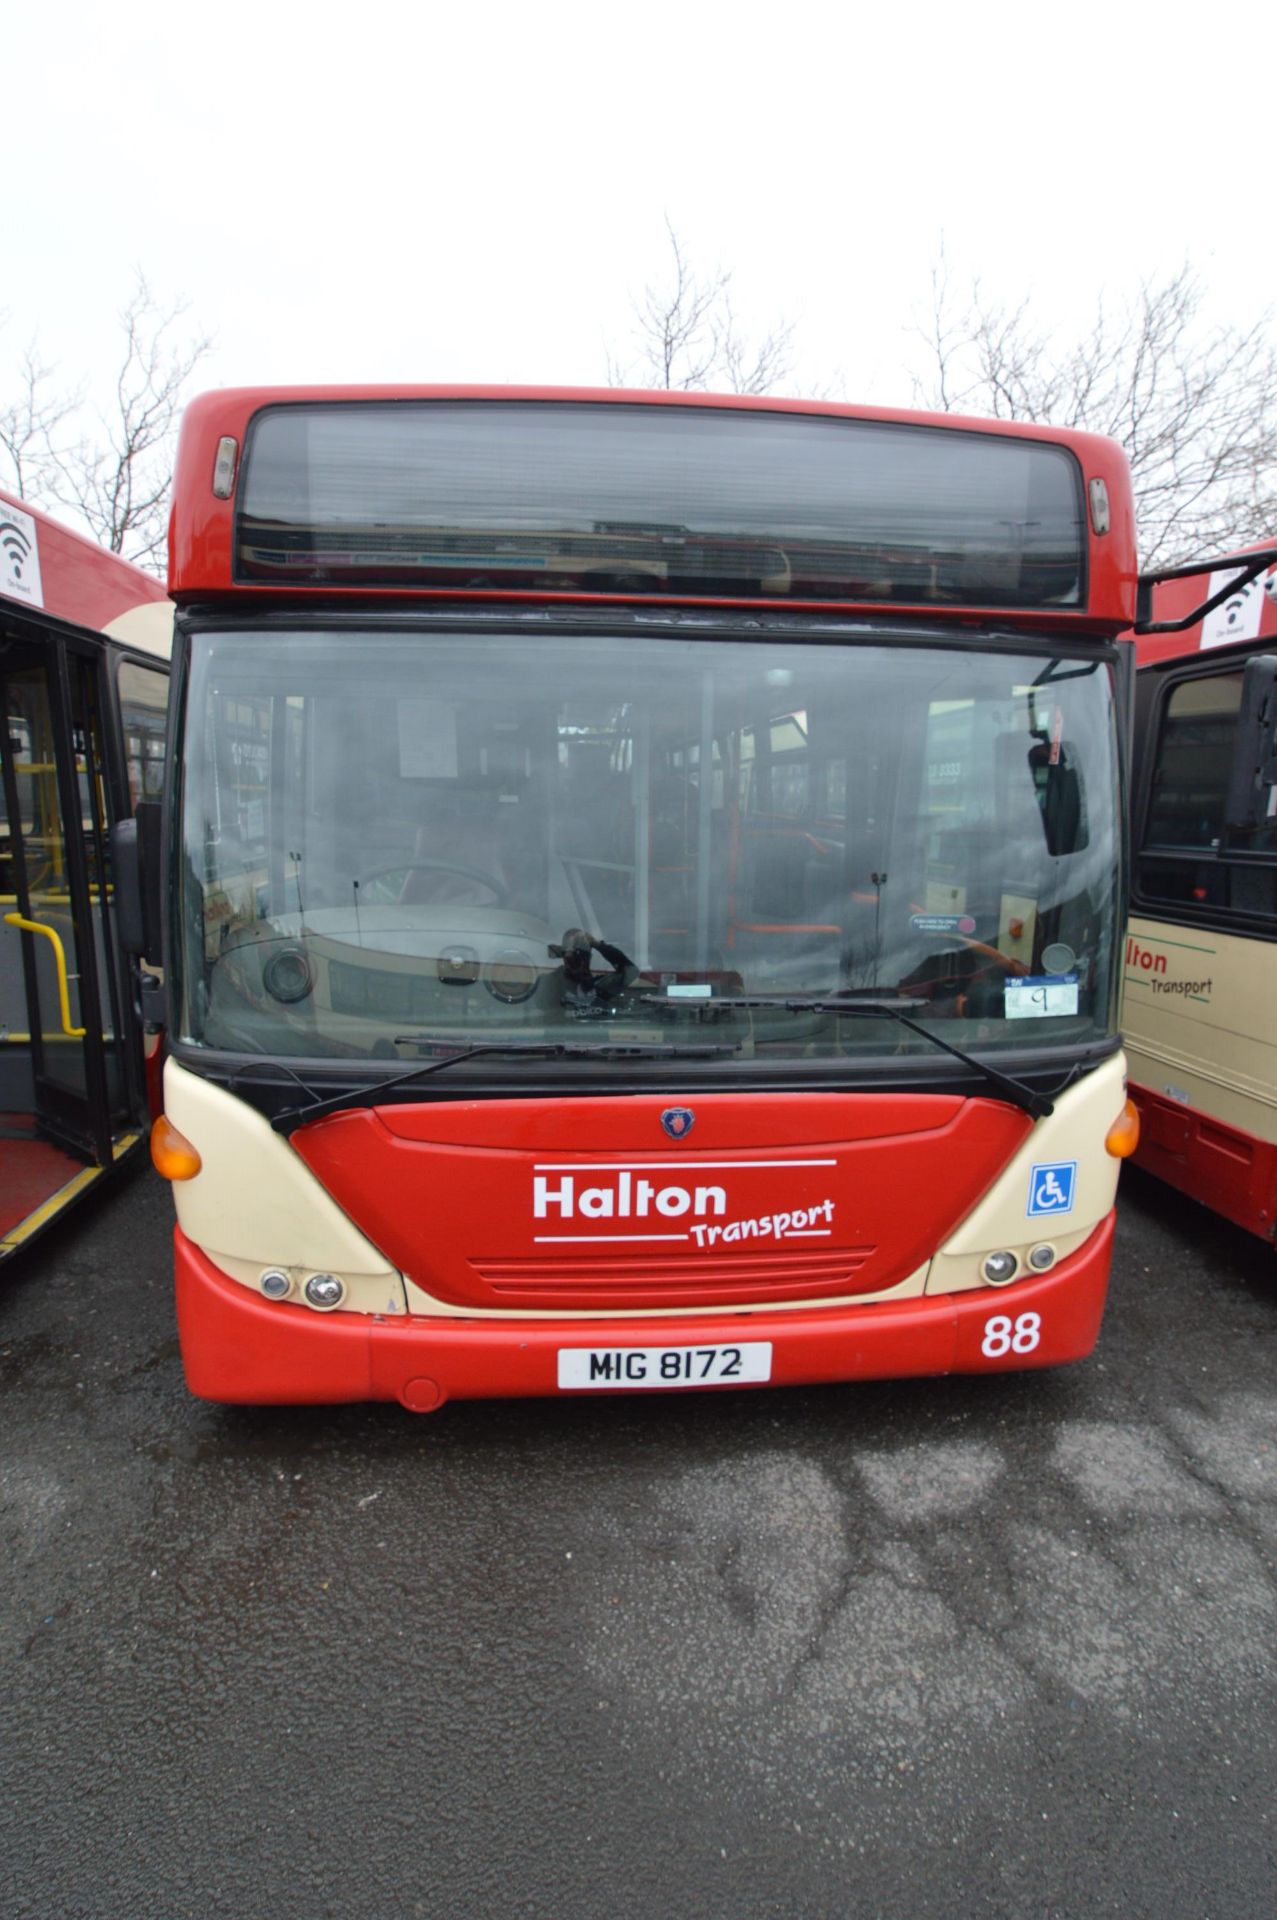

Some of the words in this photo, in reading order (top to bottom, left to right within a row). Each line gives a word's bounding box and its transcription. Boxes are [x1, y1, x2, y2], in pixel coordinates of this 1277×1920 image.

[1126, 938, 1167, 974] lton
[1031, 987, 1047, 1012] 9
[1151, 978, 1212, 998] Transport
[533, 1171, 727, 1218] Halton
[690, 1199, 835, 1247] Transport
[981, 1311, 1041, 1358] 88
[589, 1352, 647, 1381] MIG
[659, 1348, 742, 1379] 8172
